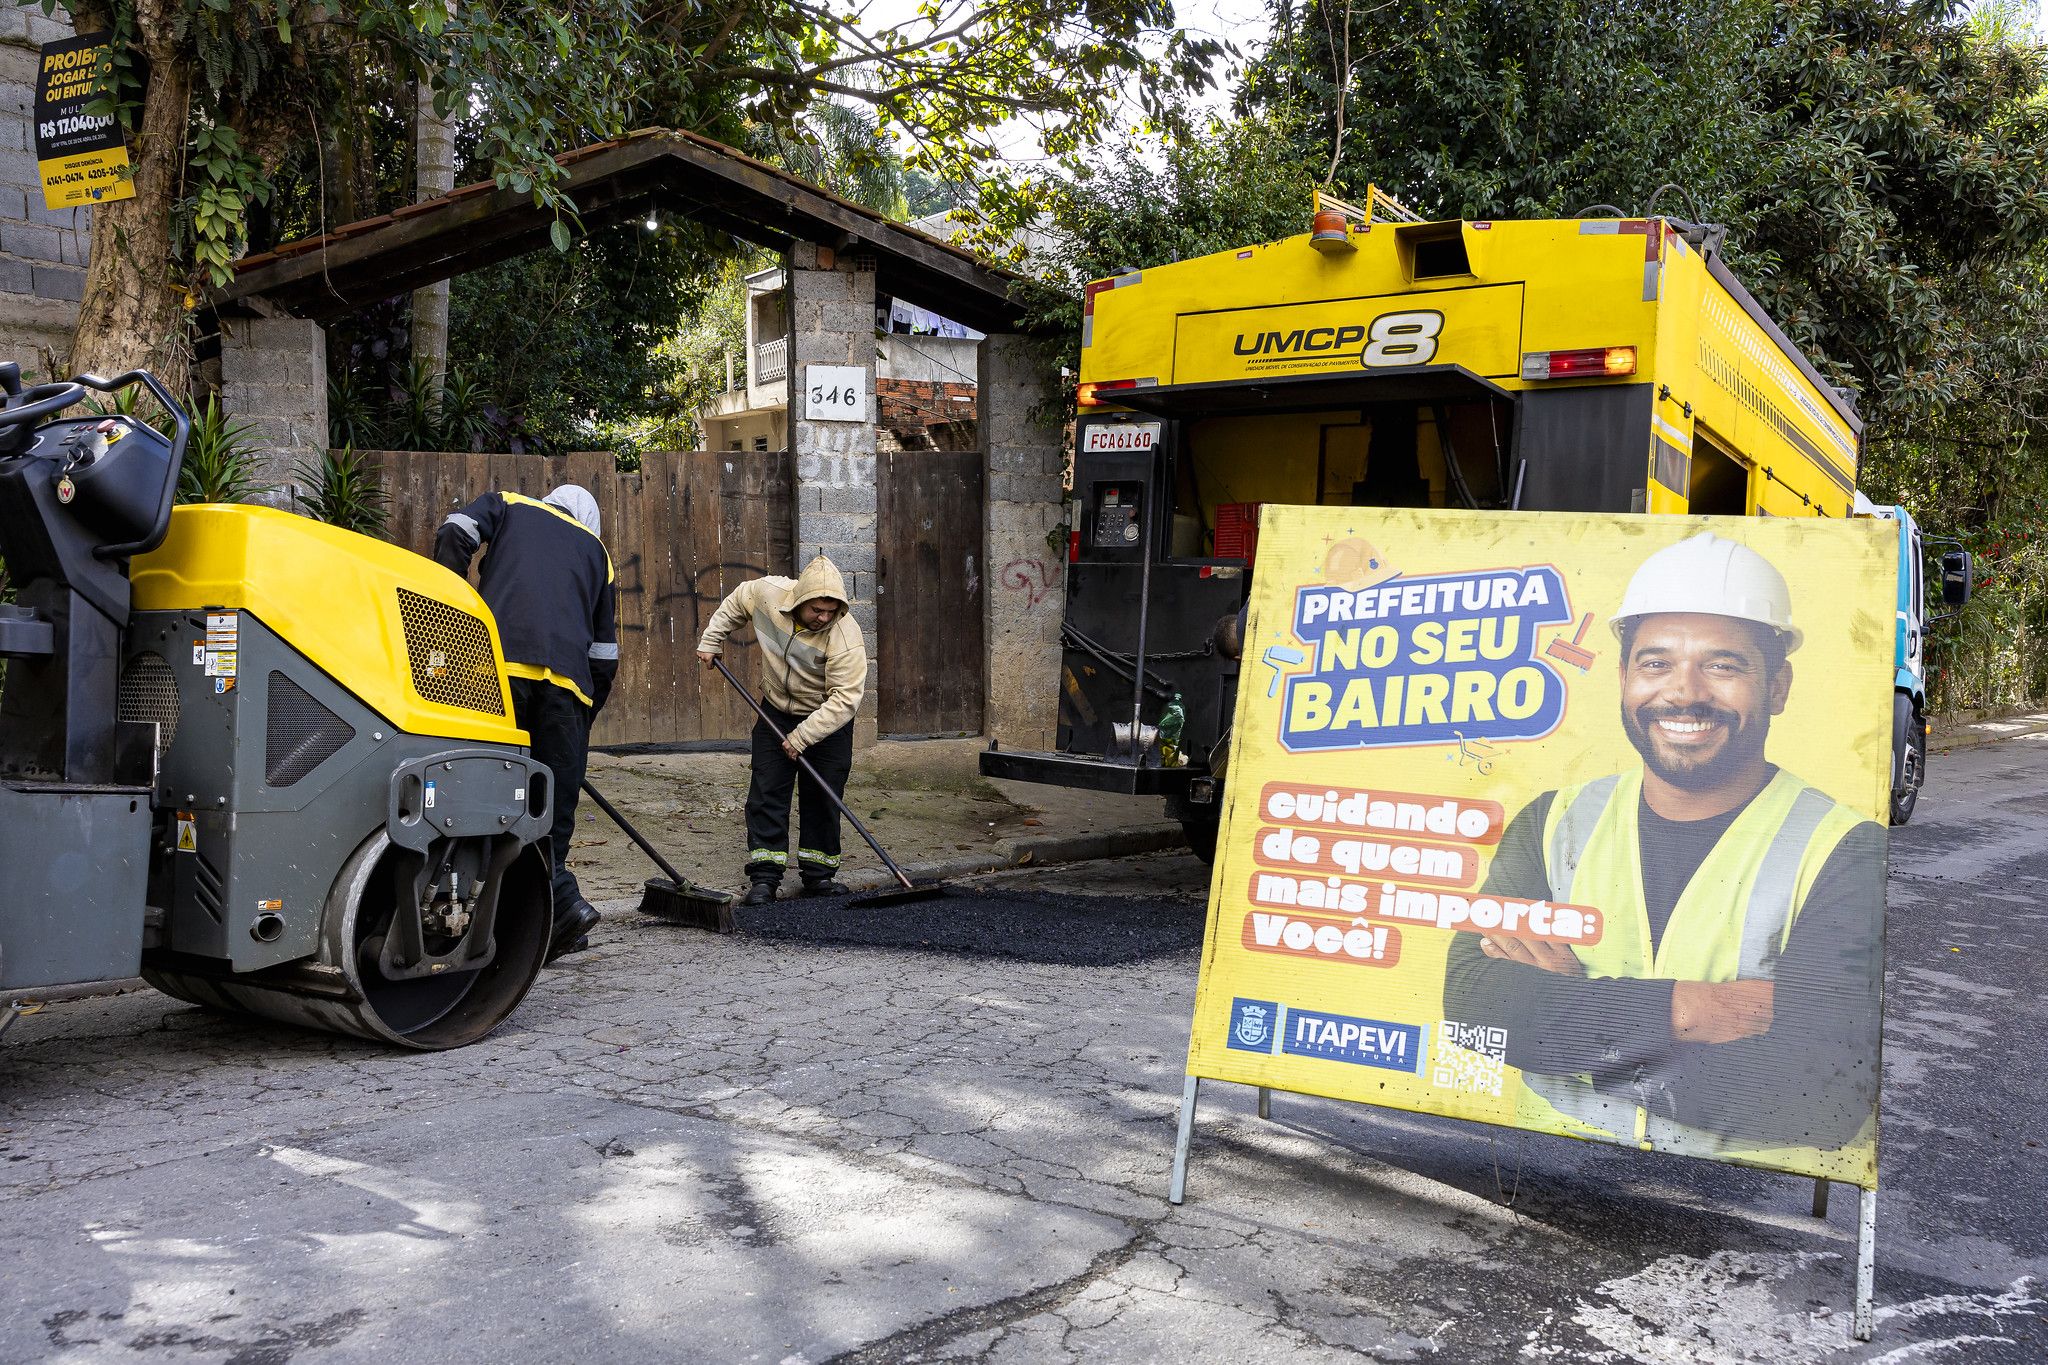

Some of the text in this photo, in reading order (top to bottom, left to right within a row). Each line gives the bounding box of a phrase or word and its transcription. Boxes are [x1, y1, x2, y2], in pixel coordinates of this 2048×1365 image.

[46, 87, 62, 102] OU
[47, 68, 86, 87] JOGAR
[40, 119, 56, 138] R$
[46, 172, 84, 186] 4141-0474
[811, 385, 856, 406] 346
[1302, 574, 1549, 625] PREFEITURA
[1320, 615, 1520, 672] NO SEU
[1289, 666, 1545, 733] BAIRRO
[1267, 790, 1490, 838] cuidando
[1262, 828, 1463, 879] de quem
[1256, 874, 1596, 939] mais importa:
[1252, 913, 1389, 960] Você!
[1294, 1041, 1405, 1064] PREFEITURA
[1296, 1016, 1407, 1056] ITAPEVI
